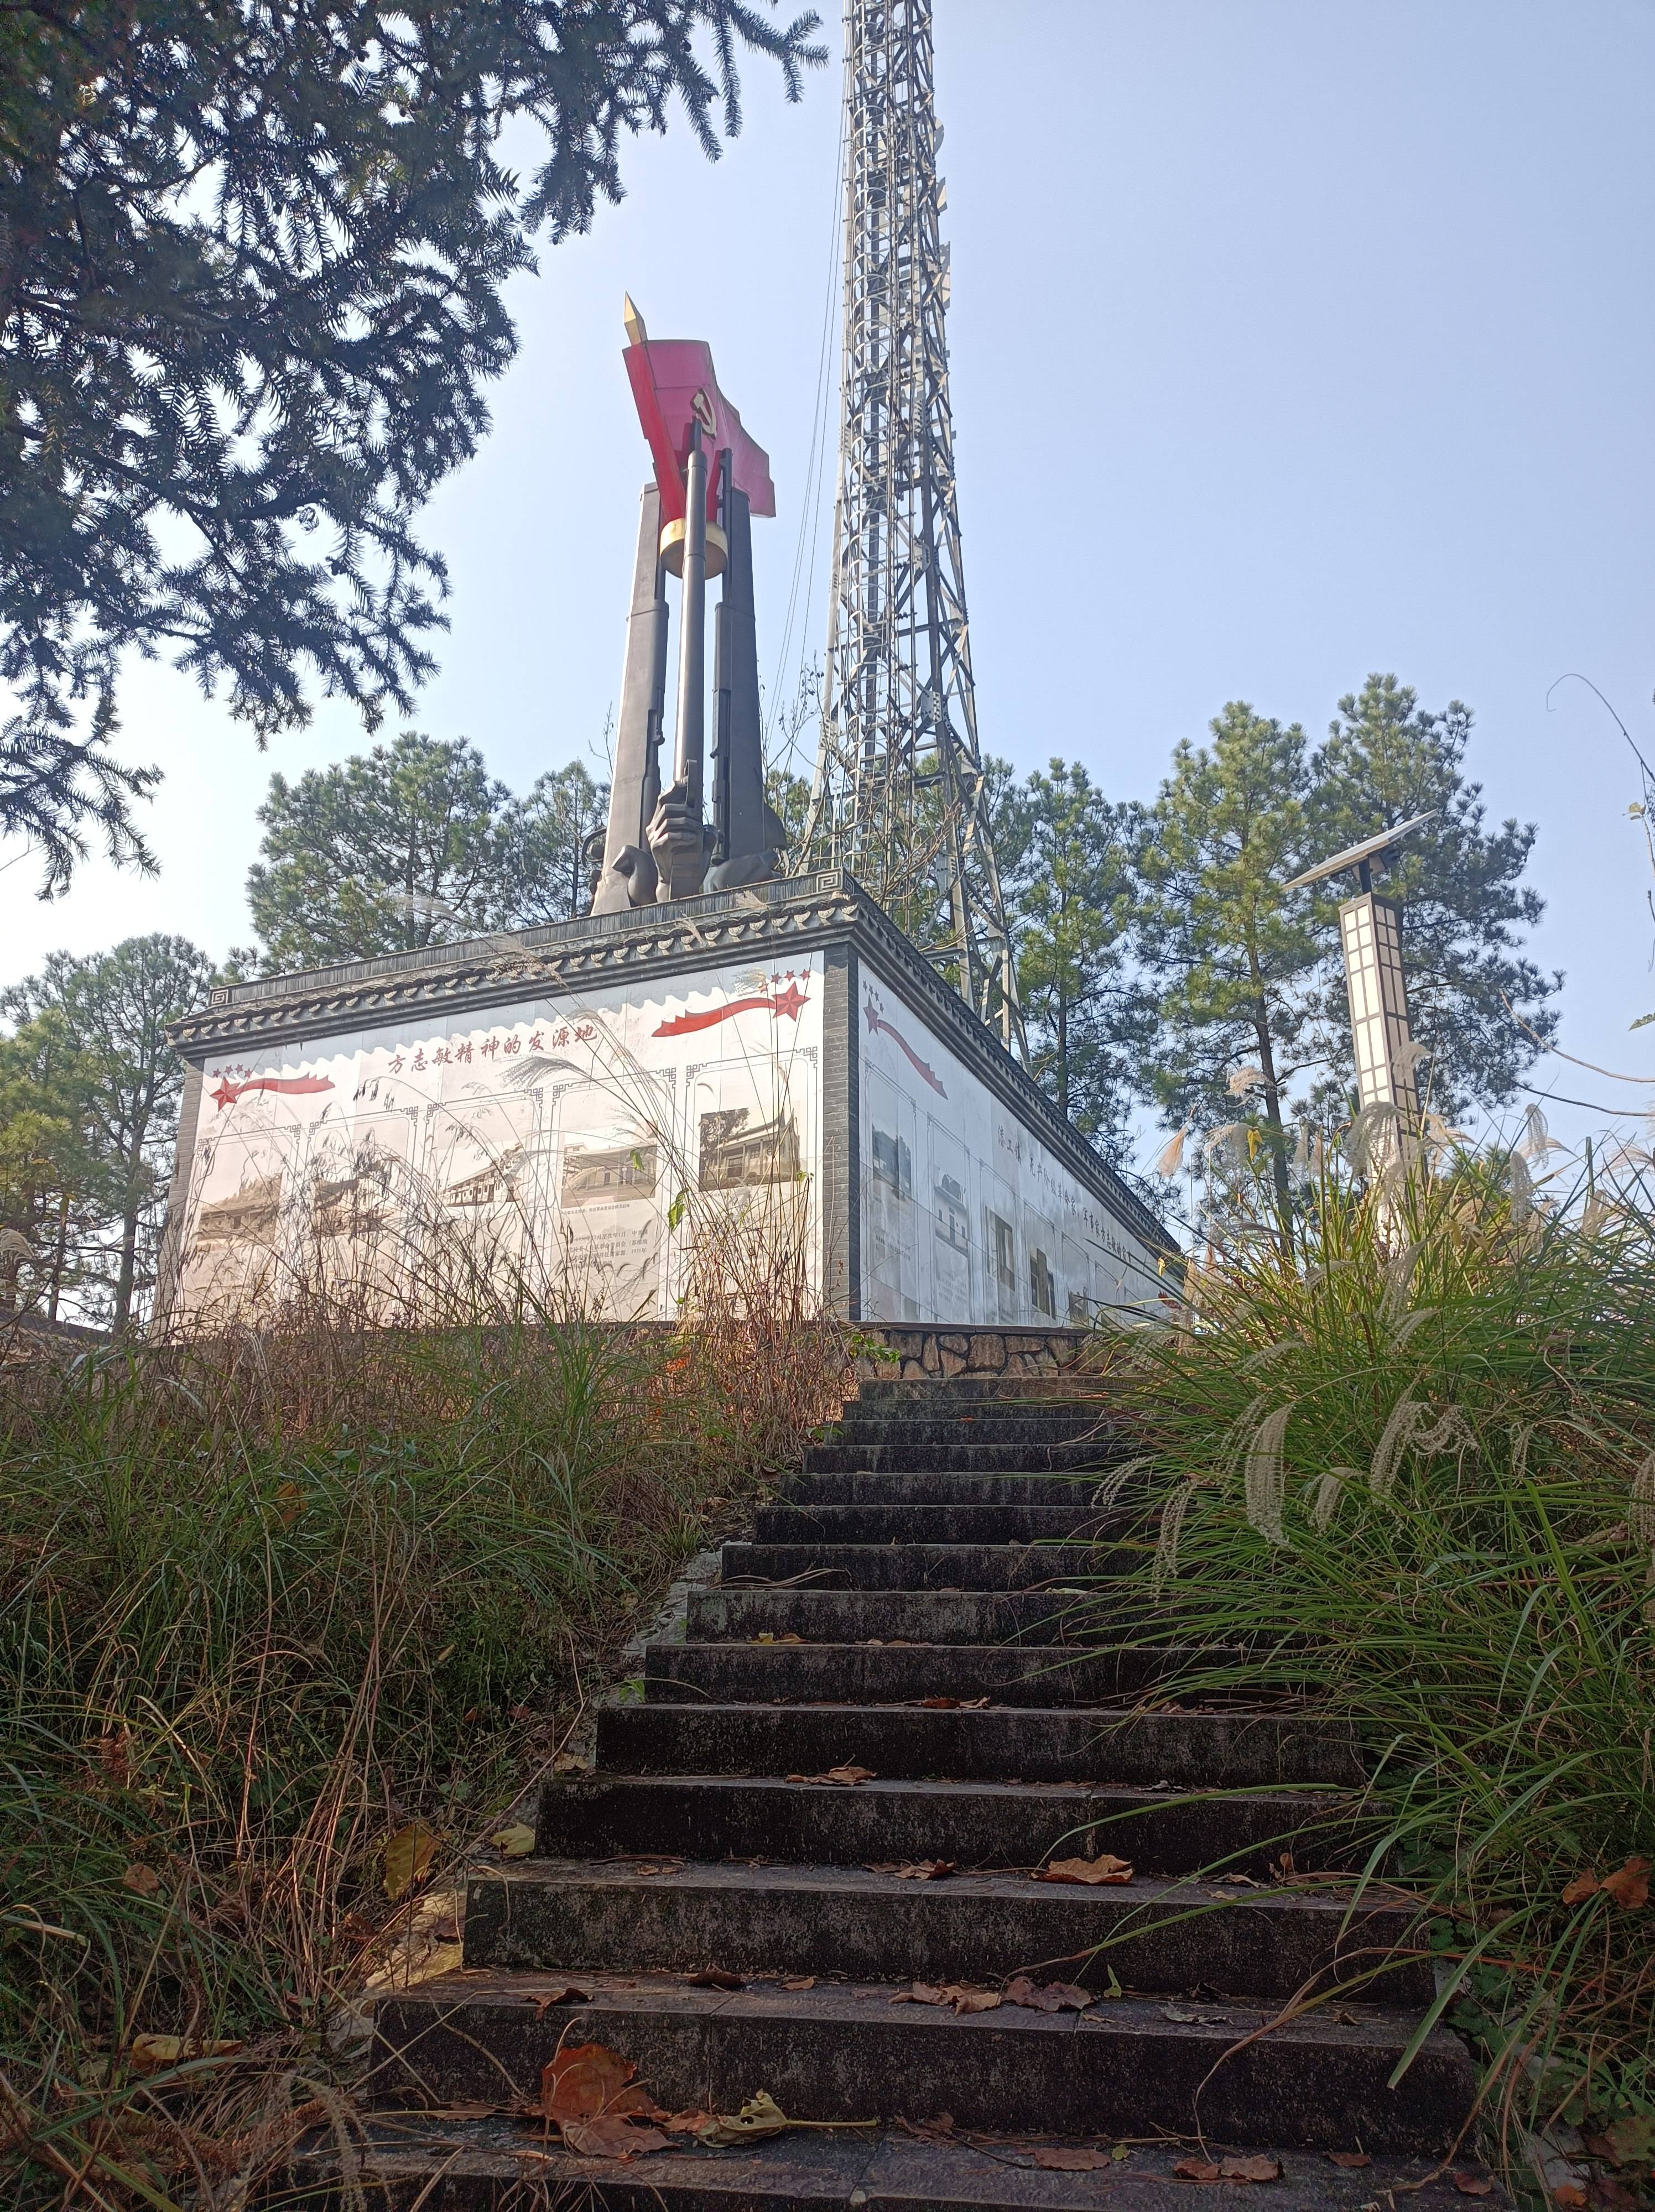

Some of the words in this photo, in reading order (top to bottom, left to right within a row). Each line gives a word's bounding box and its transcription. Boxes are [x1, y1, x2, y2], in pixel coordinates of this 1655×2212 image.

[388, 1024, 598, 1073] 方志敏精神的发源地
